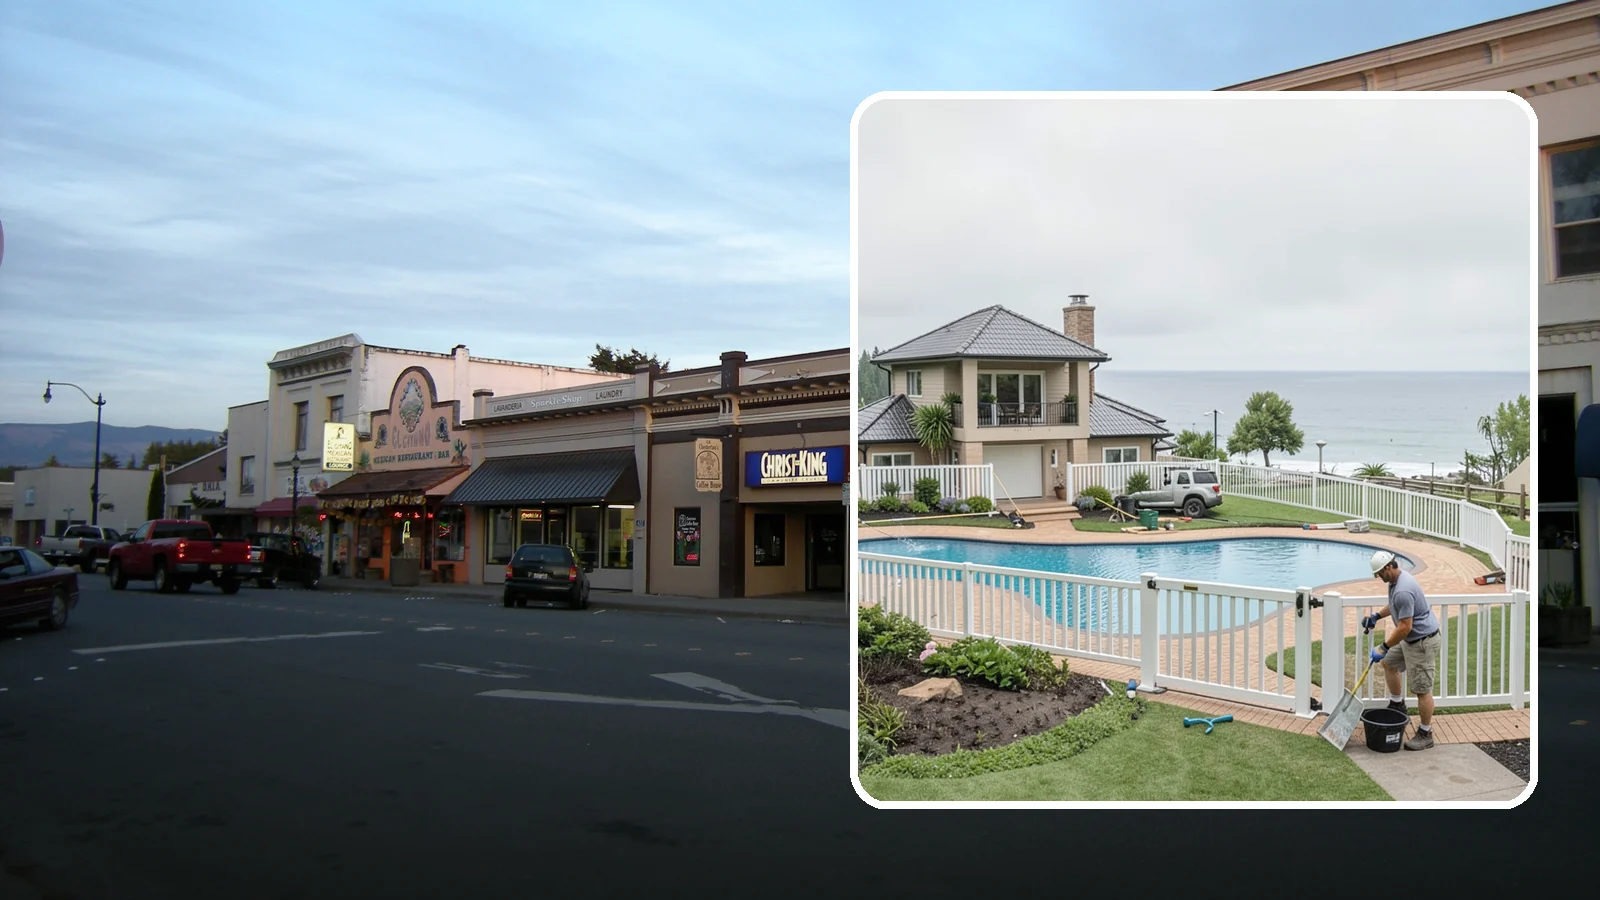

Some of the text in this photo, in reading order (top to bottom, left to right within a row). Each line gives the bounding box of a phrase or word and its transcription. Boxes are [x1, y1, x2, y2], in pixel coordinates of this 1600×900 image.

[595, 389, 623, 399] LAUNDRY
[493, 402, 522, 412] LAVANDERIA
[531, 394, 582, 409] Sparkle Shop
[374, 455, 396, 464] MEXICAN
[397, 451, 434, 463] RESTAURANT
[438, 450, 450, 459] BAR
[761, 450, 828, 477] CHRIST KING
[696, 480, 722, 489] Coffee House
